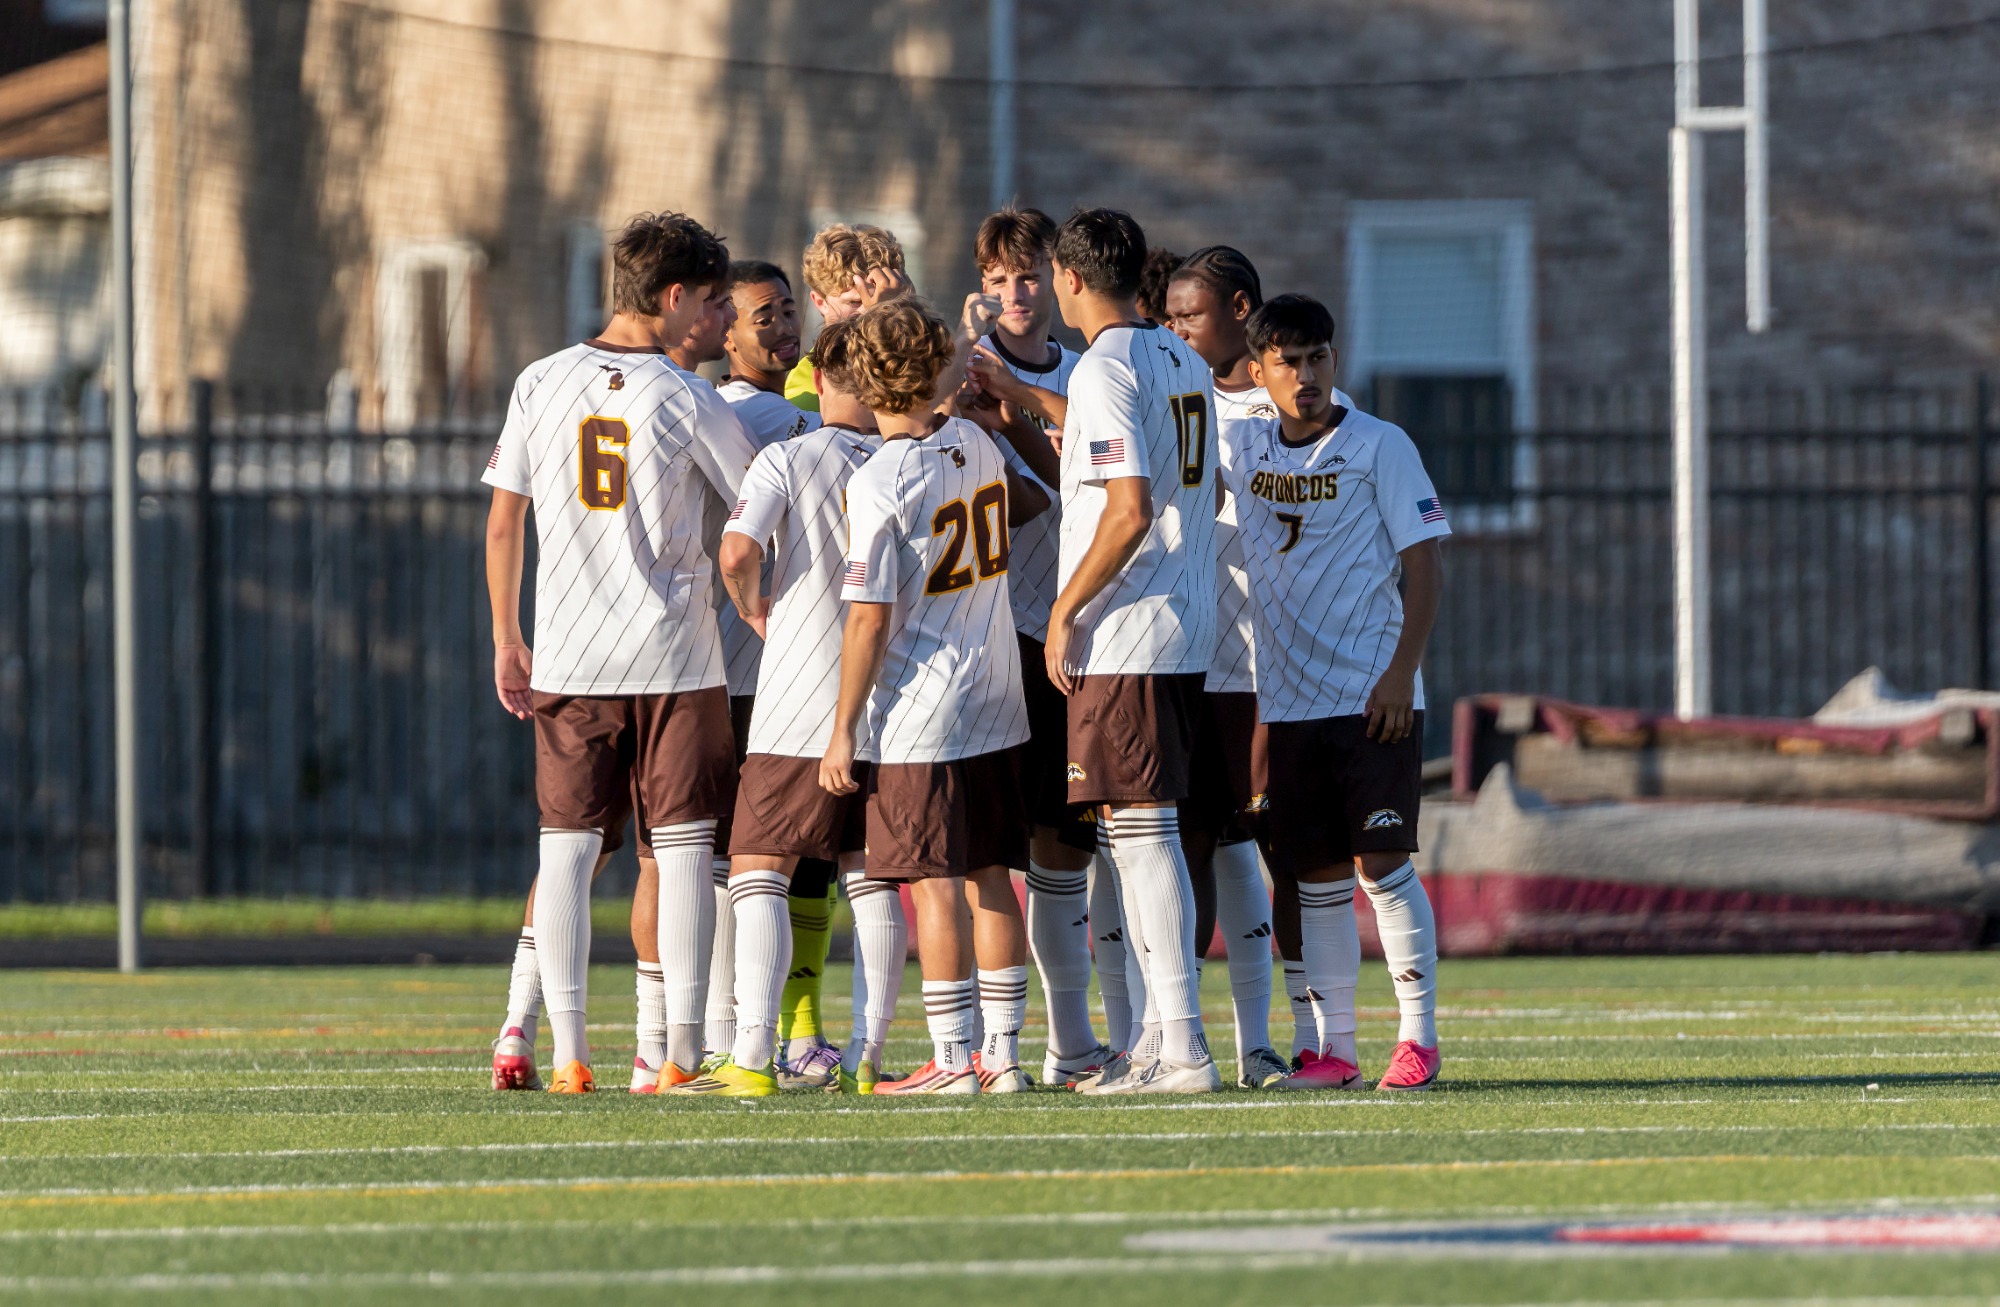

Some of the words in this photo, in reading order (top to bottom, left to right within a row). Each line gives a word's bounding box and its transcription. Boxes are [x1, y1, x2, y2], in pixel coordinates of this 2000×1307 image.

[579, 415, 631, 512] 6
[1168, 391, 1207, 488] 10
[1250, 469, 1339, 504] BRONCOS
[923, 480, 1010, 597] 20
[1275, 511, 1304, 554] 7
